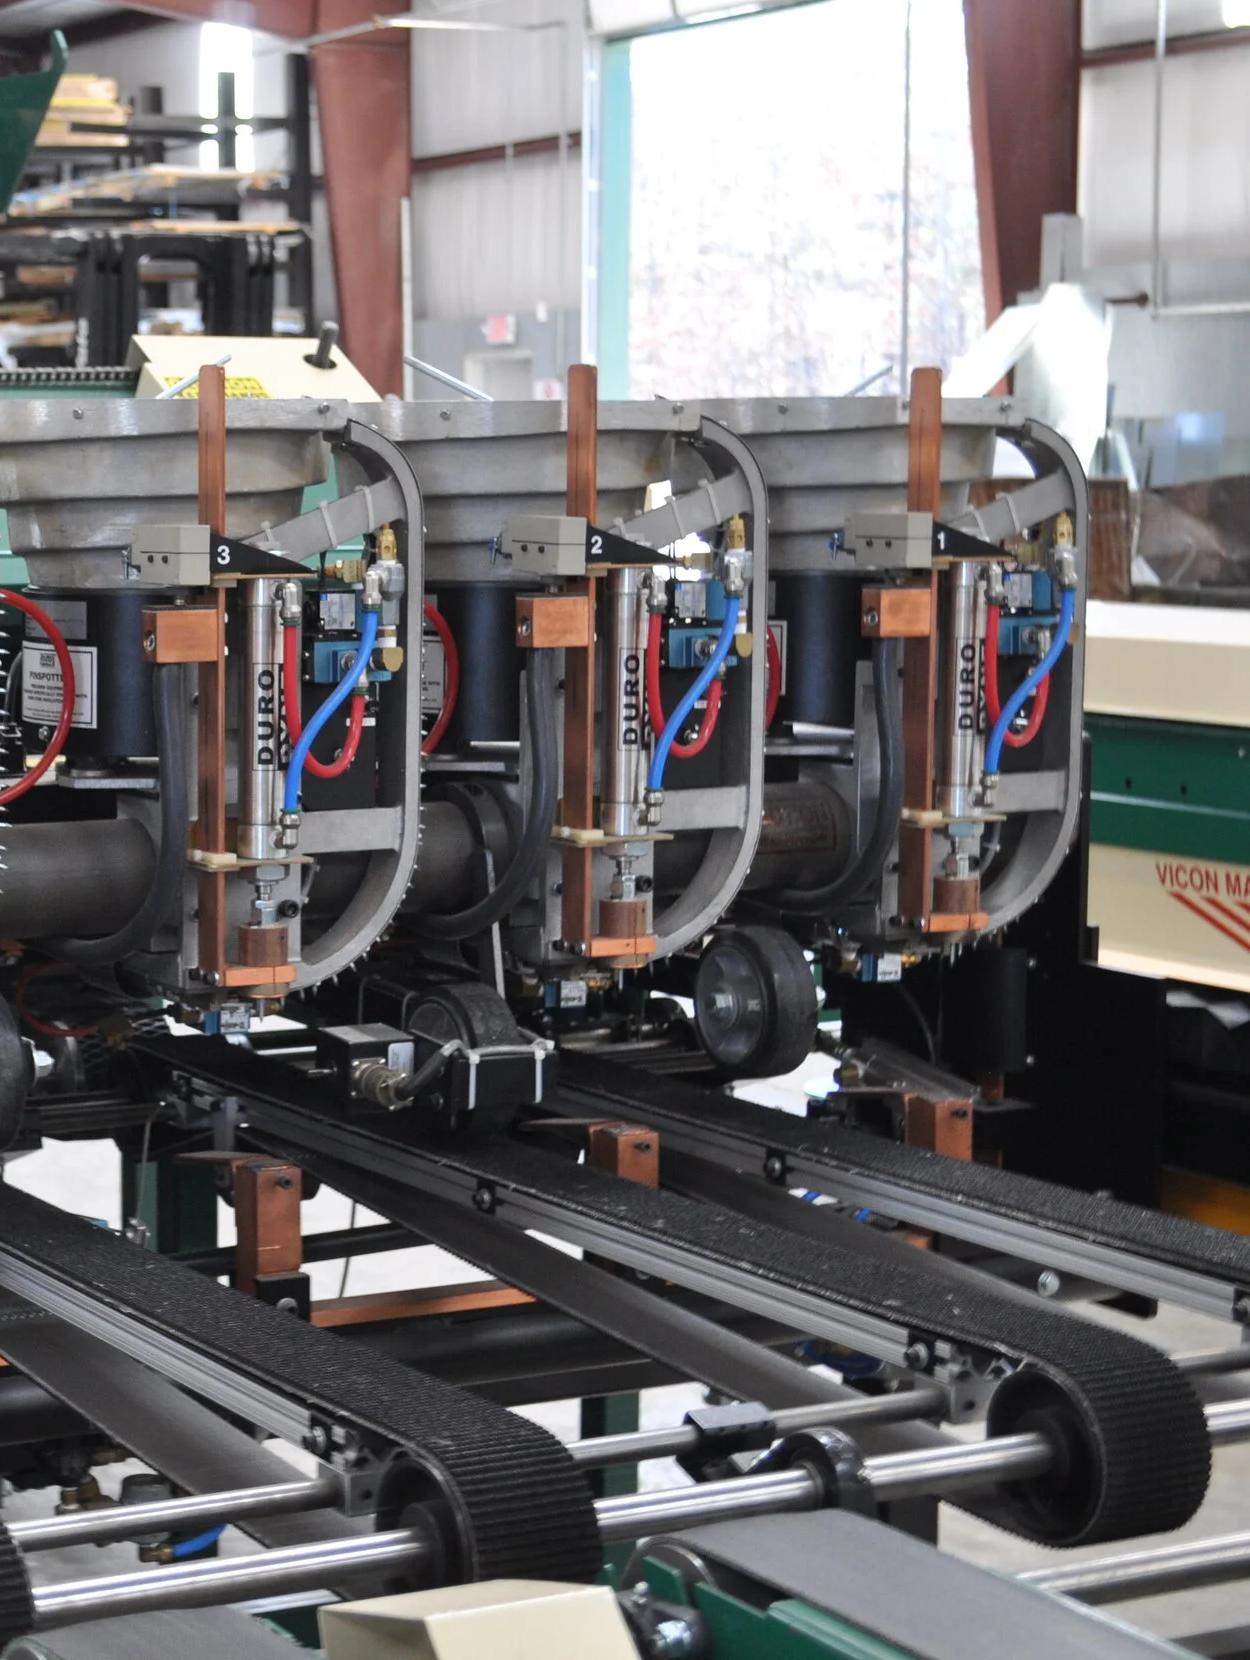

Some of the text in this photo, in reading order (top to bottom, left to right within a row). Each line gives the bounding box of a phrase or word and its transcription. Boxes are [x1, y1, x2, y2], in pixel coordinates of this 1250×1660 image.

[217, 545, 230, 565] 3
[591, 535, 603, 554] 2
[937, 531, 945, 550] 1
[623, 654, 640, 745] DURO
[958, 643, 976, 730] DURO
[257, 669, 275, 765] DURO
[1155, 861, 1219, 895] VICON
